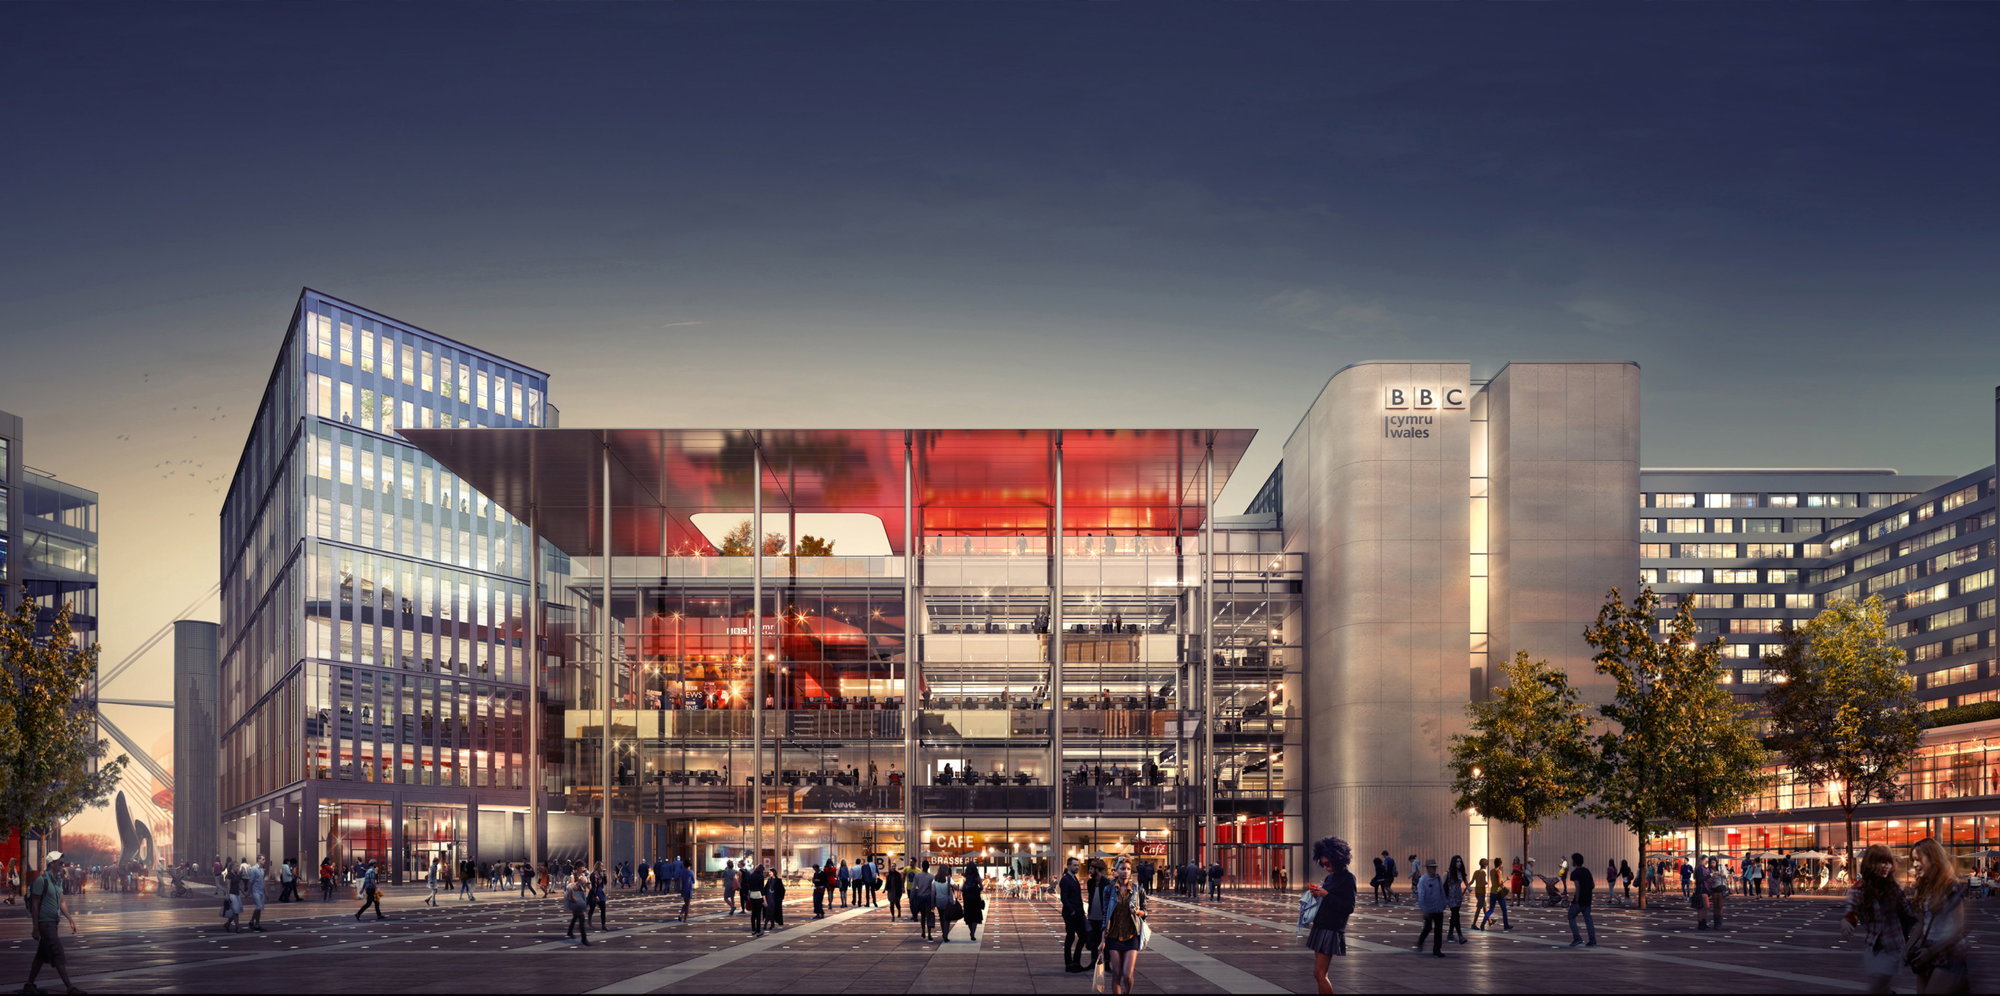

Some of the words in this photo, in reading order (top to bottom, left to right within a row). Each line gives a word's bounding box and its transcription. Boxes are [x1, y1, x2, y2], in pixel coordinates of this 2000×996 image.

[1391, 388, 1463, 406] BBC
[1390, 415, 1433, 428] cymru
[1390, 427, 1430, 438] wales
[685, 691, 703, 699] EWS
[936, 834, 975, 849] CAFE
[1142, 843, 1166, 856] Café
